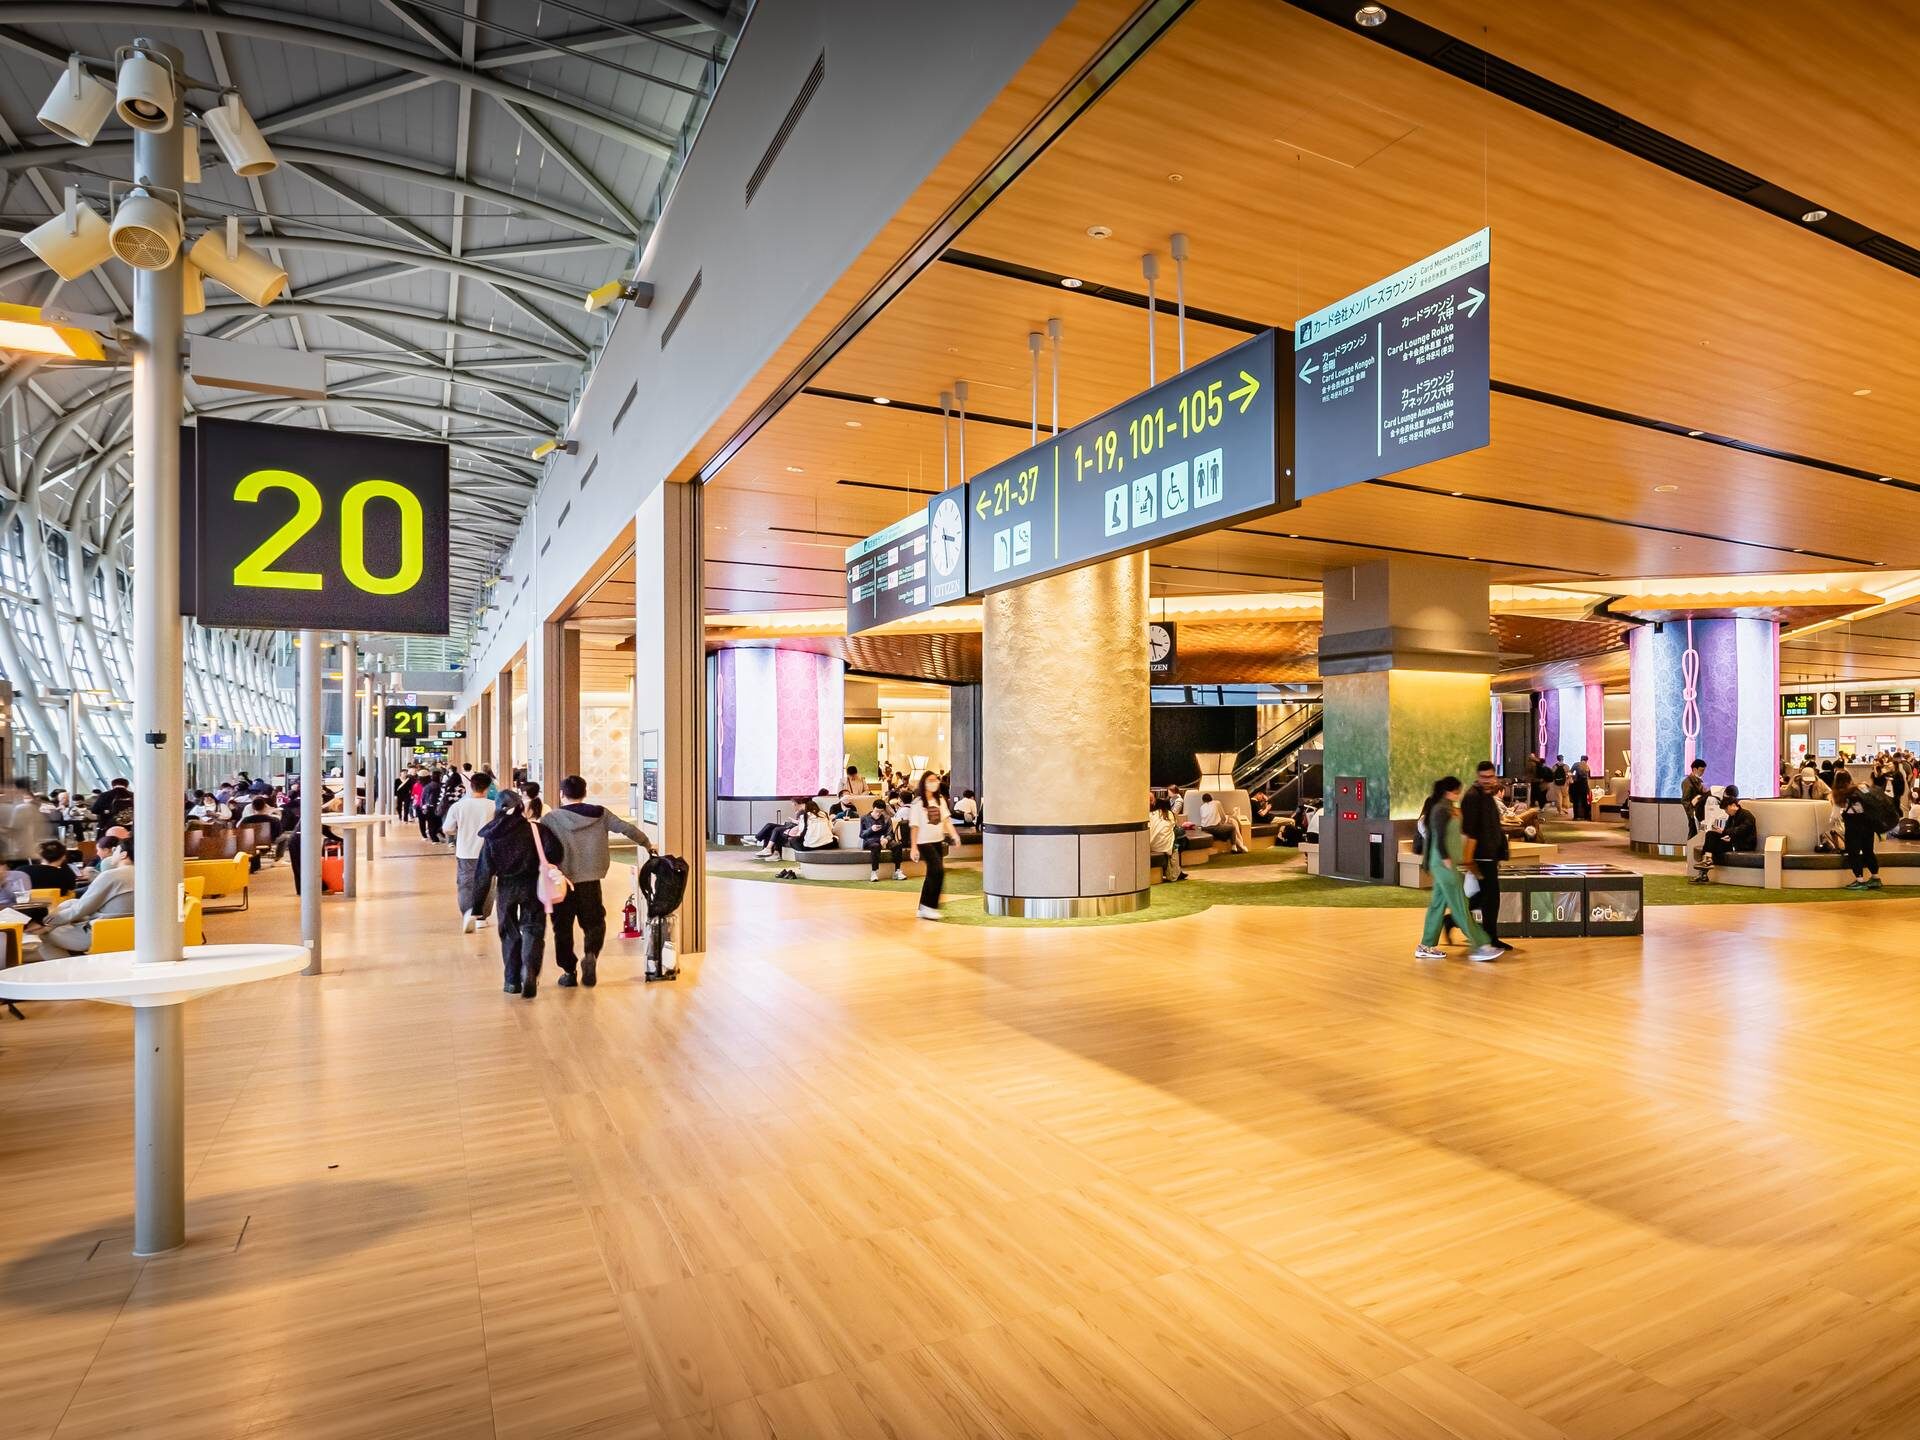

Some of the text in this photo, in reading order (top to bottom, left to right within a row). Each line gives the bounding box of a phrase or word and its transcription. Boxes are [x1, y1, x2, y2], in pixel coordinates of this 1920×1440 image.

[1420, 240, 1482, 275] Card Members Lounge
[1314, 272, 1417, 335] カード会社メンバーズラウンジ
[1401, 294, 1455, 328] カードラウンジ
[1437, 306, 1454, 325] 六甲
[1322, 333, 1367, 362] カードラウンジ
[1387, 323, 1454, 357] Card Lounge Rokko
[1321, 355, 1375, 384] Card Lounge Kongoh
[1401, 369, 1455, 400] カードラウンジ
[1401, 382, 1454, 412] アネックス六甲
[1383, 398, 1454, 429] Card Lounge Annex Rokko
[1074, 380, 1224, 482] 1-19, 101-105
[994, 465, 1039, 516] 21-37
[233, 469, 424, 595] 20
[394, 711, 423, 733] 21
[414, 746, 425, 754] 22
